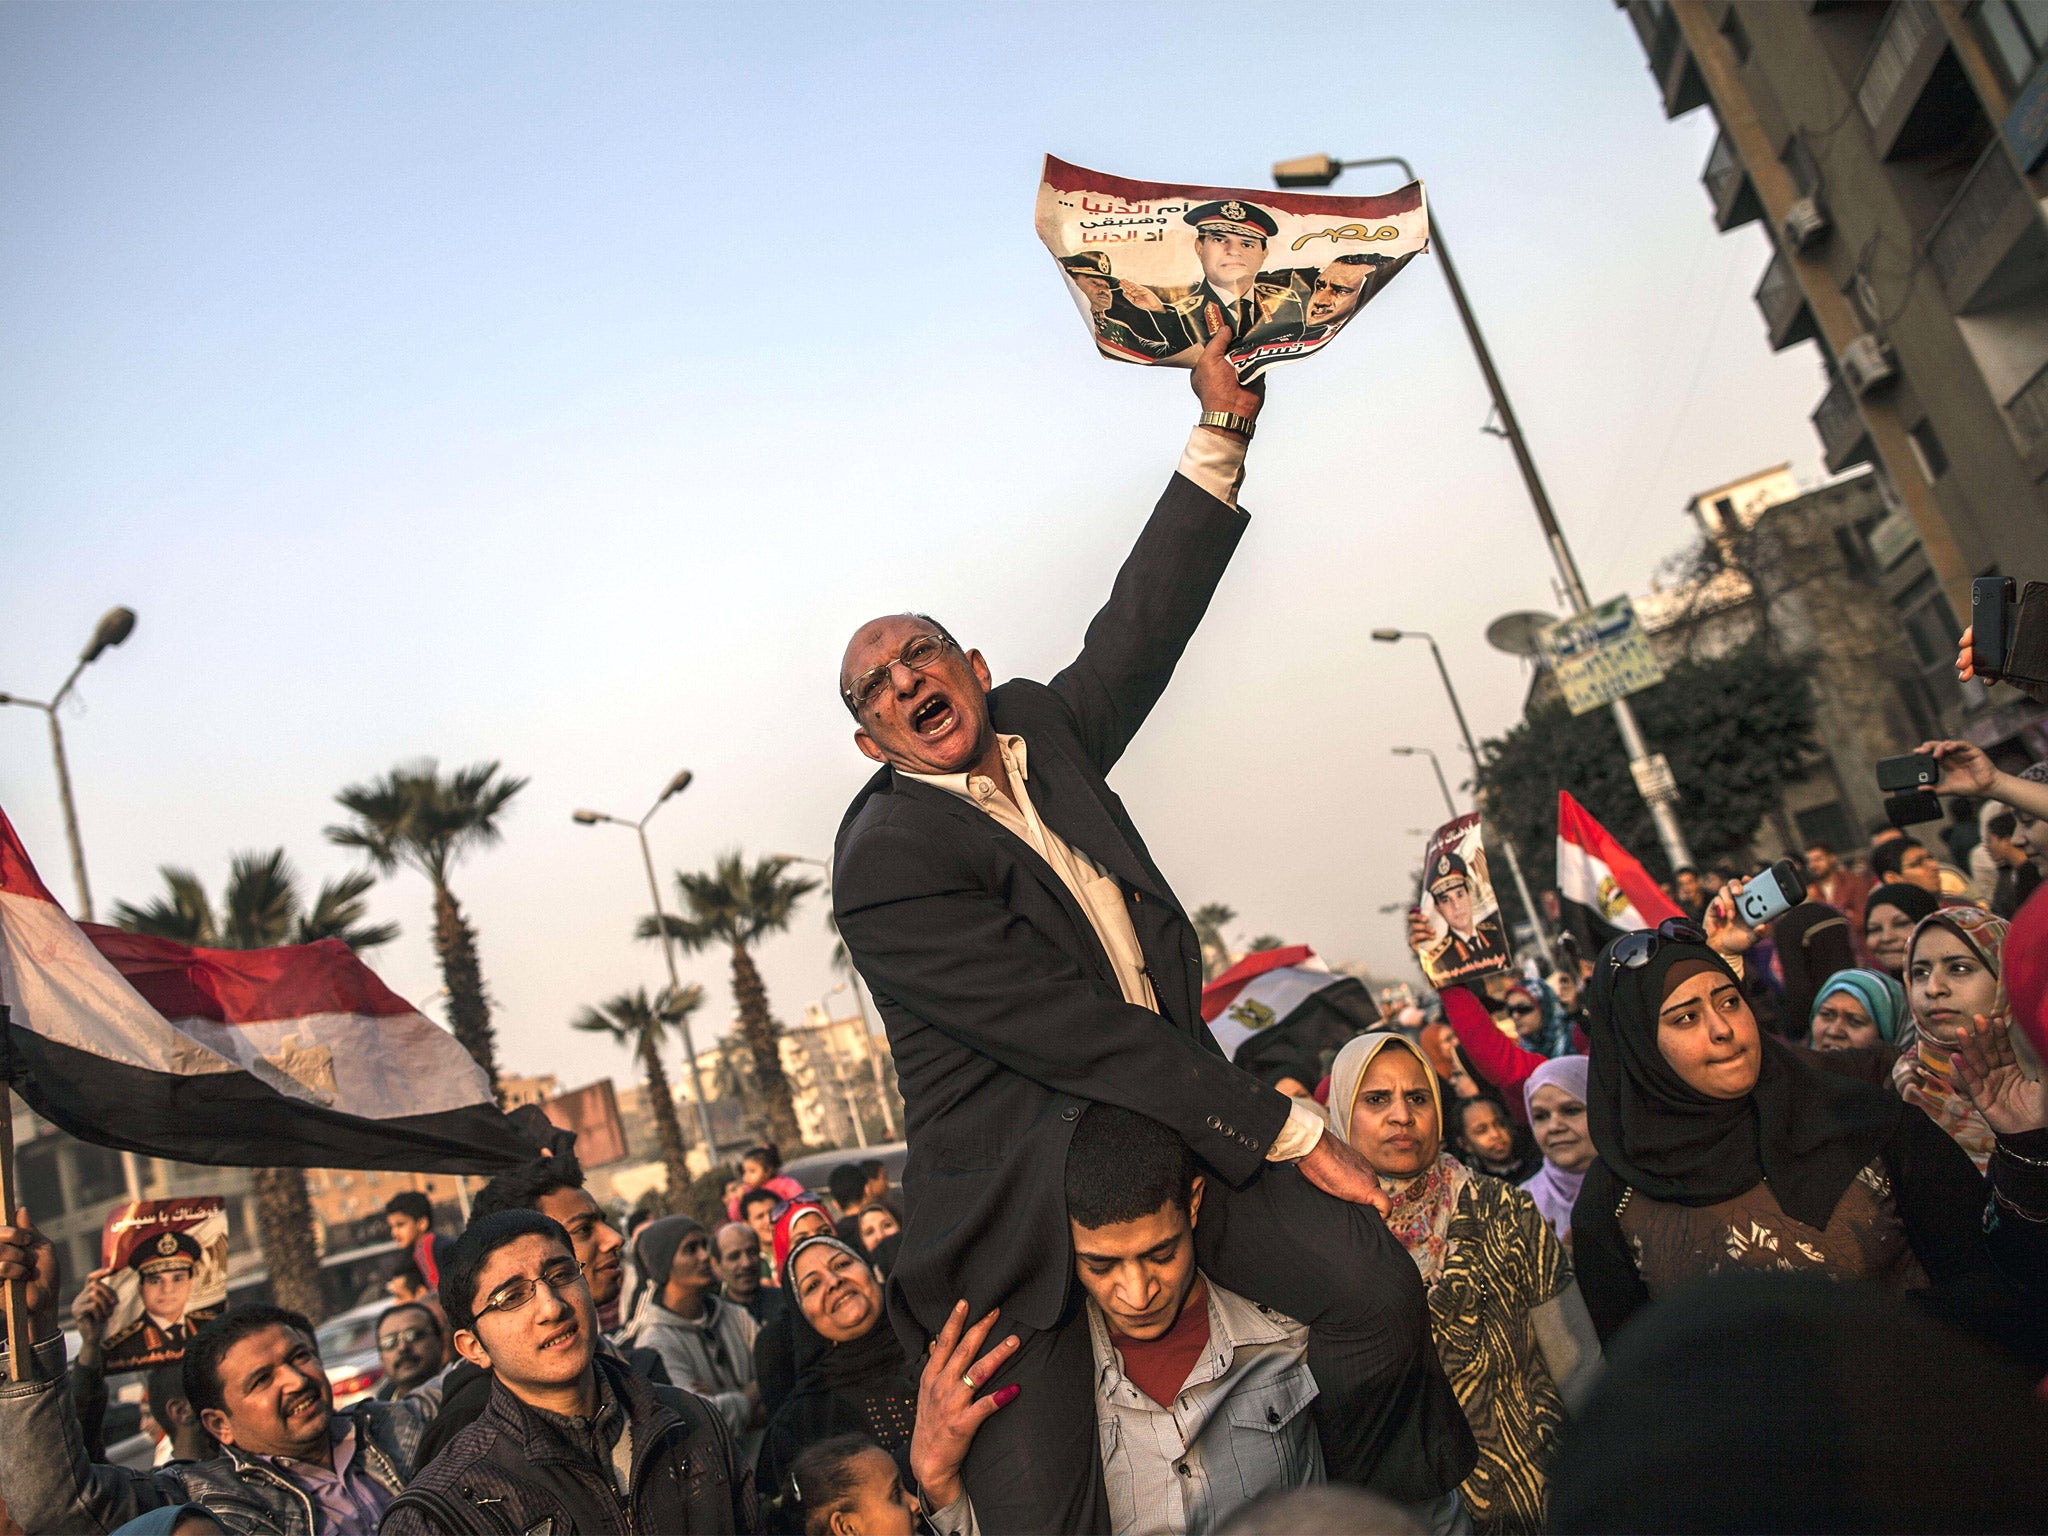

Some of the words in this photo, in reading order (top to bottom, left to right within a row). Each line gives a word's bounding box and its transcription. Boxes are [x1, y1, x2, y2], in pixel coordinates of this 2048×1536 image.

[1082, 197, 1150, 215] الدنيا
[1082, 230, 1138, 243] الدنيا
[1291, 223, 1400, 251] مصر
